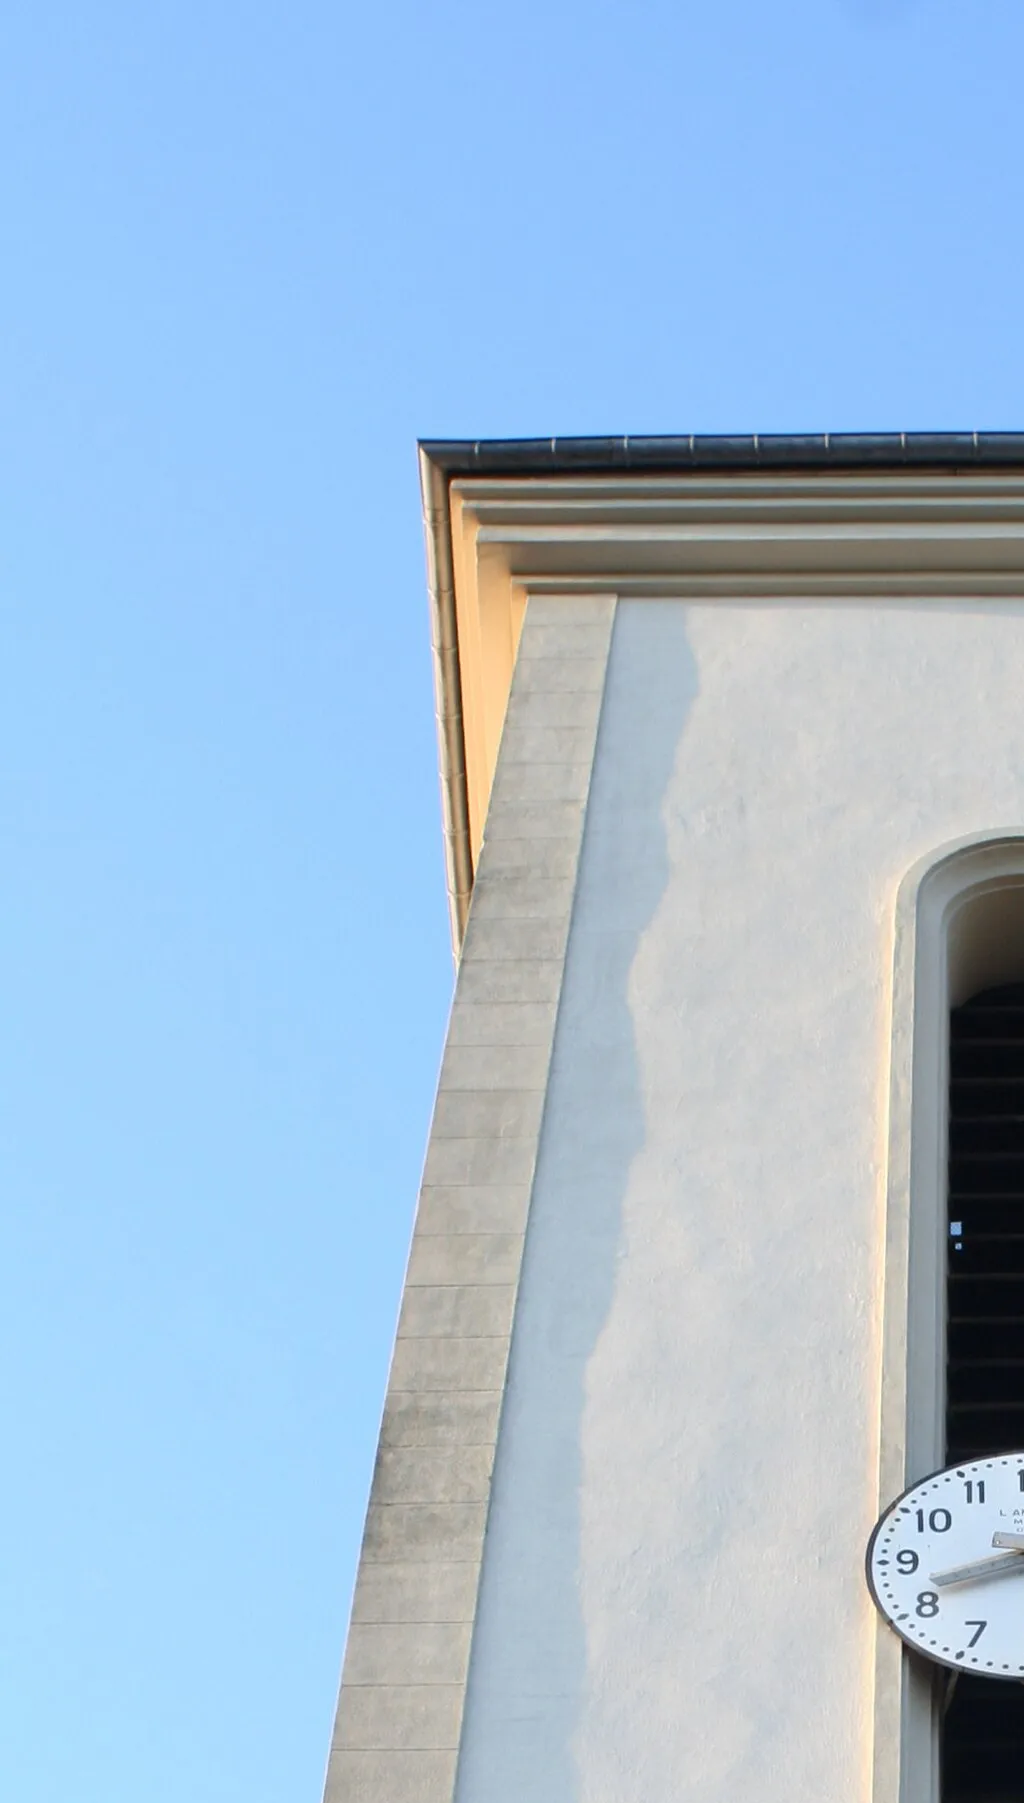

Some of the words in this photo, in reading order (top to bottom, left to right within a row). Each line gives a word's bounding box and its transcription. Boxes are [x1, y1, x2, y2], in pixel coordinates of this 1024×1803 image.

[963, 1480, 985, 1504] 11
[915, 1508, 952, 1533] 10
[896, 1549, 919, 1575] 9
[916, 1591, 940, 1618] 8
[965, 1621, 988, 1648] 7
